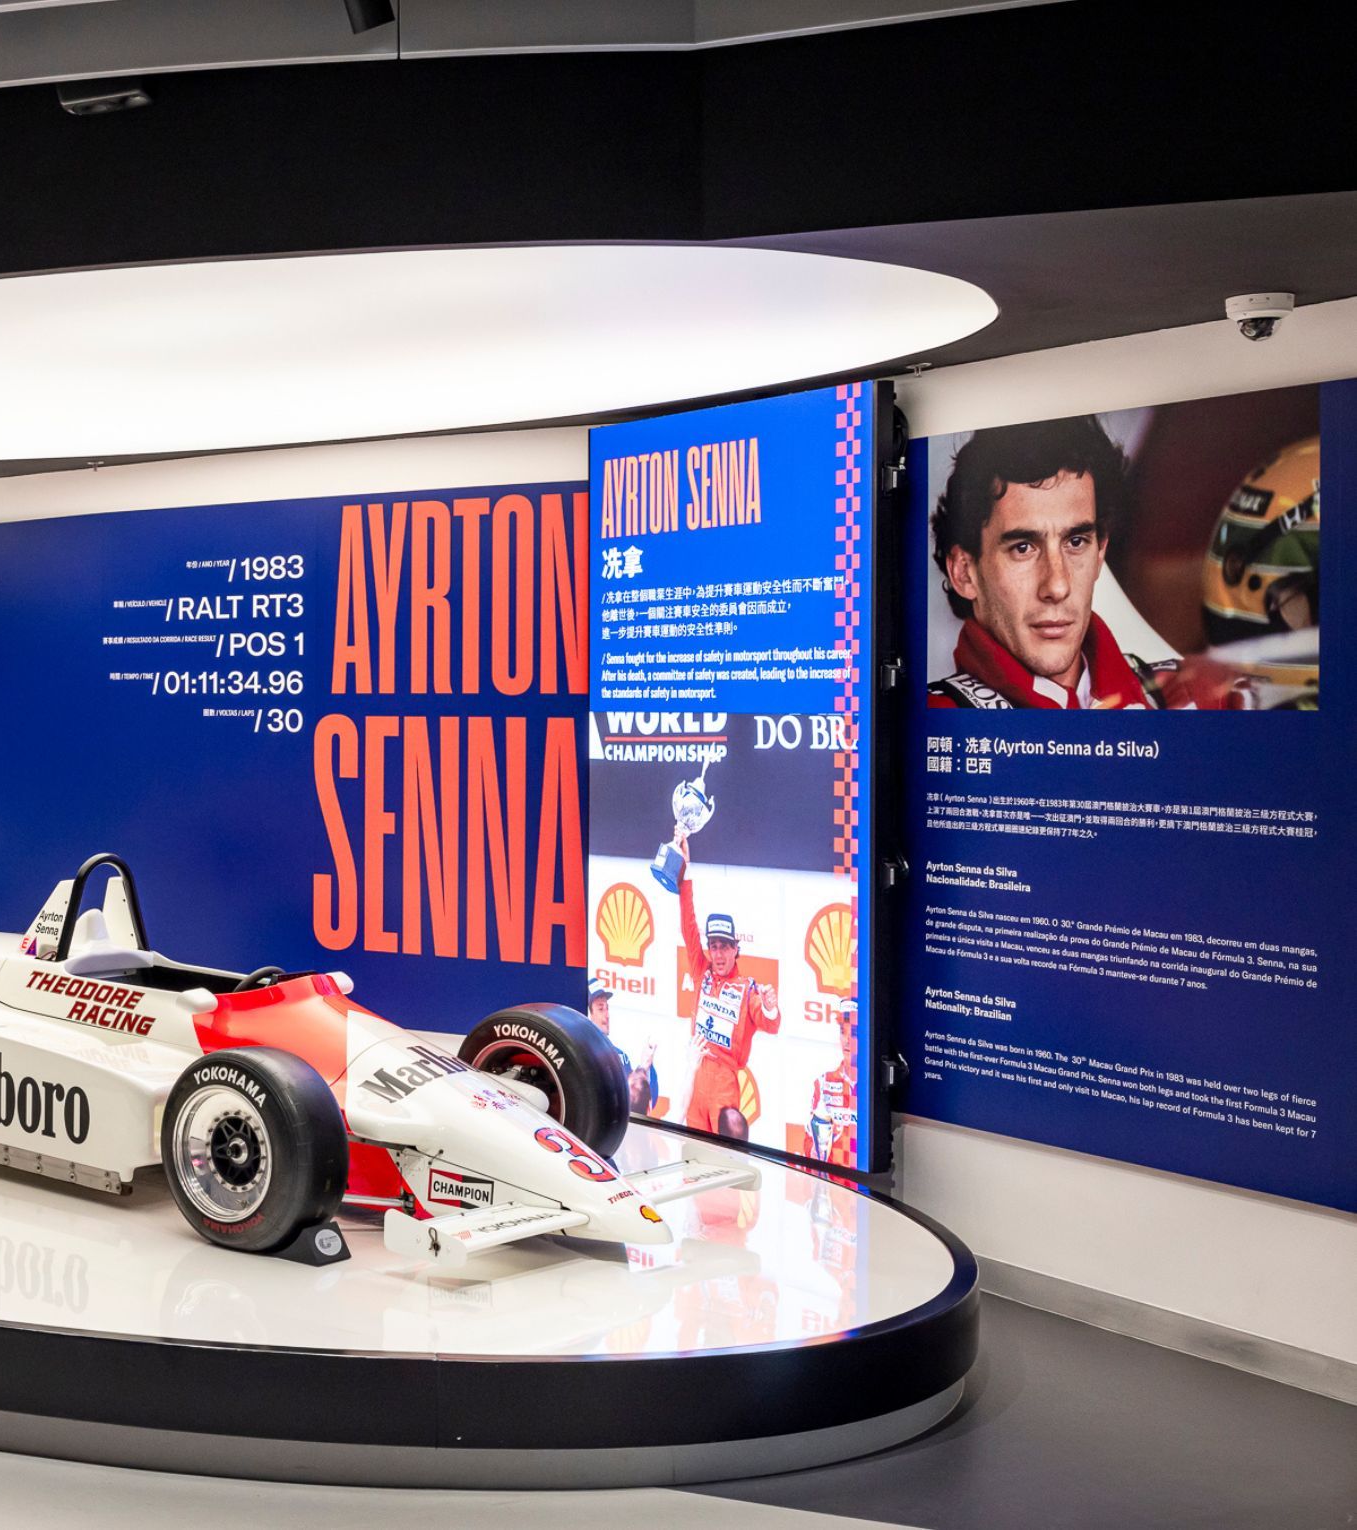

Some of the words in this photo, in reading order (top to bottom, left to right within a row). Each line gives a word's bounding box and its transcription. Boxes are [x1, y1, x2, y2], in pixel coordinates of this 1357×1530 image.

[601, 449, 679, 539] AYRTON
[686, 437, 761, 531] SENNA
[601, 545, 643, 580] 冼拿
[252, 594, 304, 618] RT3
[331, 492, 588, 696] AYRTON
[294, 632, 304, 656] 1
[606, 652, 624, 664] Senna
[625, 652, 644, 667] fought
[646, 652, 654, 664] for
[655, 651, 666, 663] the
[667, 651, 694, 663] increase
[703, 650, 723, 665] safety
[733, 649, 771, 664] motorsport
[772, 648, 812, 663] throughout
[813, 648, 825, 660] his
[826, 648, 852, 660] career.
[601, 669, 616, 681] After
[617, 669, 626, 681] his
[627, 669, 646, 682] death,
[652, 668, 686, 681] committee
[694, 668, 715, 683] safety
[716, 668, 729, 680] was
[730, 668, 758, 682] created,
[760, 667, 786, 682] leading
[795, 667, 808, 680] the
[809, 666, 841, 680] increase
[601, 686, 611, 698] the
[612, 686, 642, 698] standards
[650, 686, 669, 701] safety
[678, 686, 716, 701] motorsport.
[754, 715, 802, 750] DO
[809, 715, 859, 750] BR
[1047, 740, 1091, 756] Senna
[1095, 741, 1113, 756] da
[1117, 741, 1159, 759] Silva)
[313, 713, 587, 968] SENNA
[926, 860, 954, 875] Ayrton
[954, 863, 982, 874] Senna
[982, 865, 994, 875] da
[995, 866, 1017, 877] Silva
[926, 873, 987, 888] Nacionalidade:
[989, 879, 1030, 892] Brasileira
[39, 910, 64, 923] Ayrton
[35, 923, 59, 936] Senna
[26, 971, 145, 1010] THEODORE
[596, 968, 656, 995] Shell
[924, 986, 952, 1002] Ayrton
[953, 990, 981, 1003] Senna
[981, 994, 993, 1005] da
[994, 996, 1016, 1008] Silva
[66, 1000, 156, 1036] RACING
[925, 998, 972, 1016] Nationality:
[974, 1006, 1011, 1021] Brazilian
[493, 1024, 565, 1070] YOKOHAMA
[924, 1030, 945, 1040] Ayrton
[946, 1033, 966, 1044] Senna
[967, 1037, 976, 1046] da
[977, 1038, 993, 1049] Silva
[1008, 1044, 1025, 1054] born
[1026, 1048, 1034, 1056] in
[1034, 1049, 1053, 1059] 1960.
[1054, 1052, 1068, 1062] The
[1088, 1058, 1113, 1070] Macau
[1114, 1062, 1138, 1074] Grand
[1139, 1067, 1154, 1077] Prix
[1156, 1070, 1164, 1079] in
[1165, 1072, 1184, 1083] 1983
[1185, 1077, 1201, 1086] was
[1203, 1078, 1221, 1089] held
[1222, 1084, 1241, 1093] over
[1242, 1086, 1259, 1096] two
[1260, 1088, 1278, 1101] legs
[1280, 1092, 1290, 1101] of
[1291, 1094, 1316, 1106] fierce
[194, 1066, 267, 1108] YOKOHAMA
[433, 1181, 490, 1202] CHAMPION
